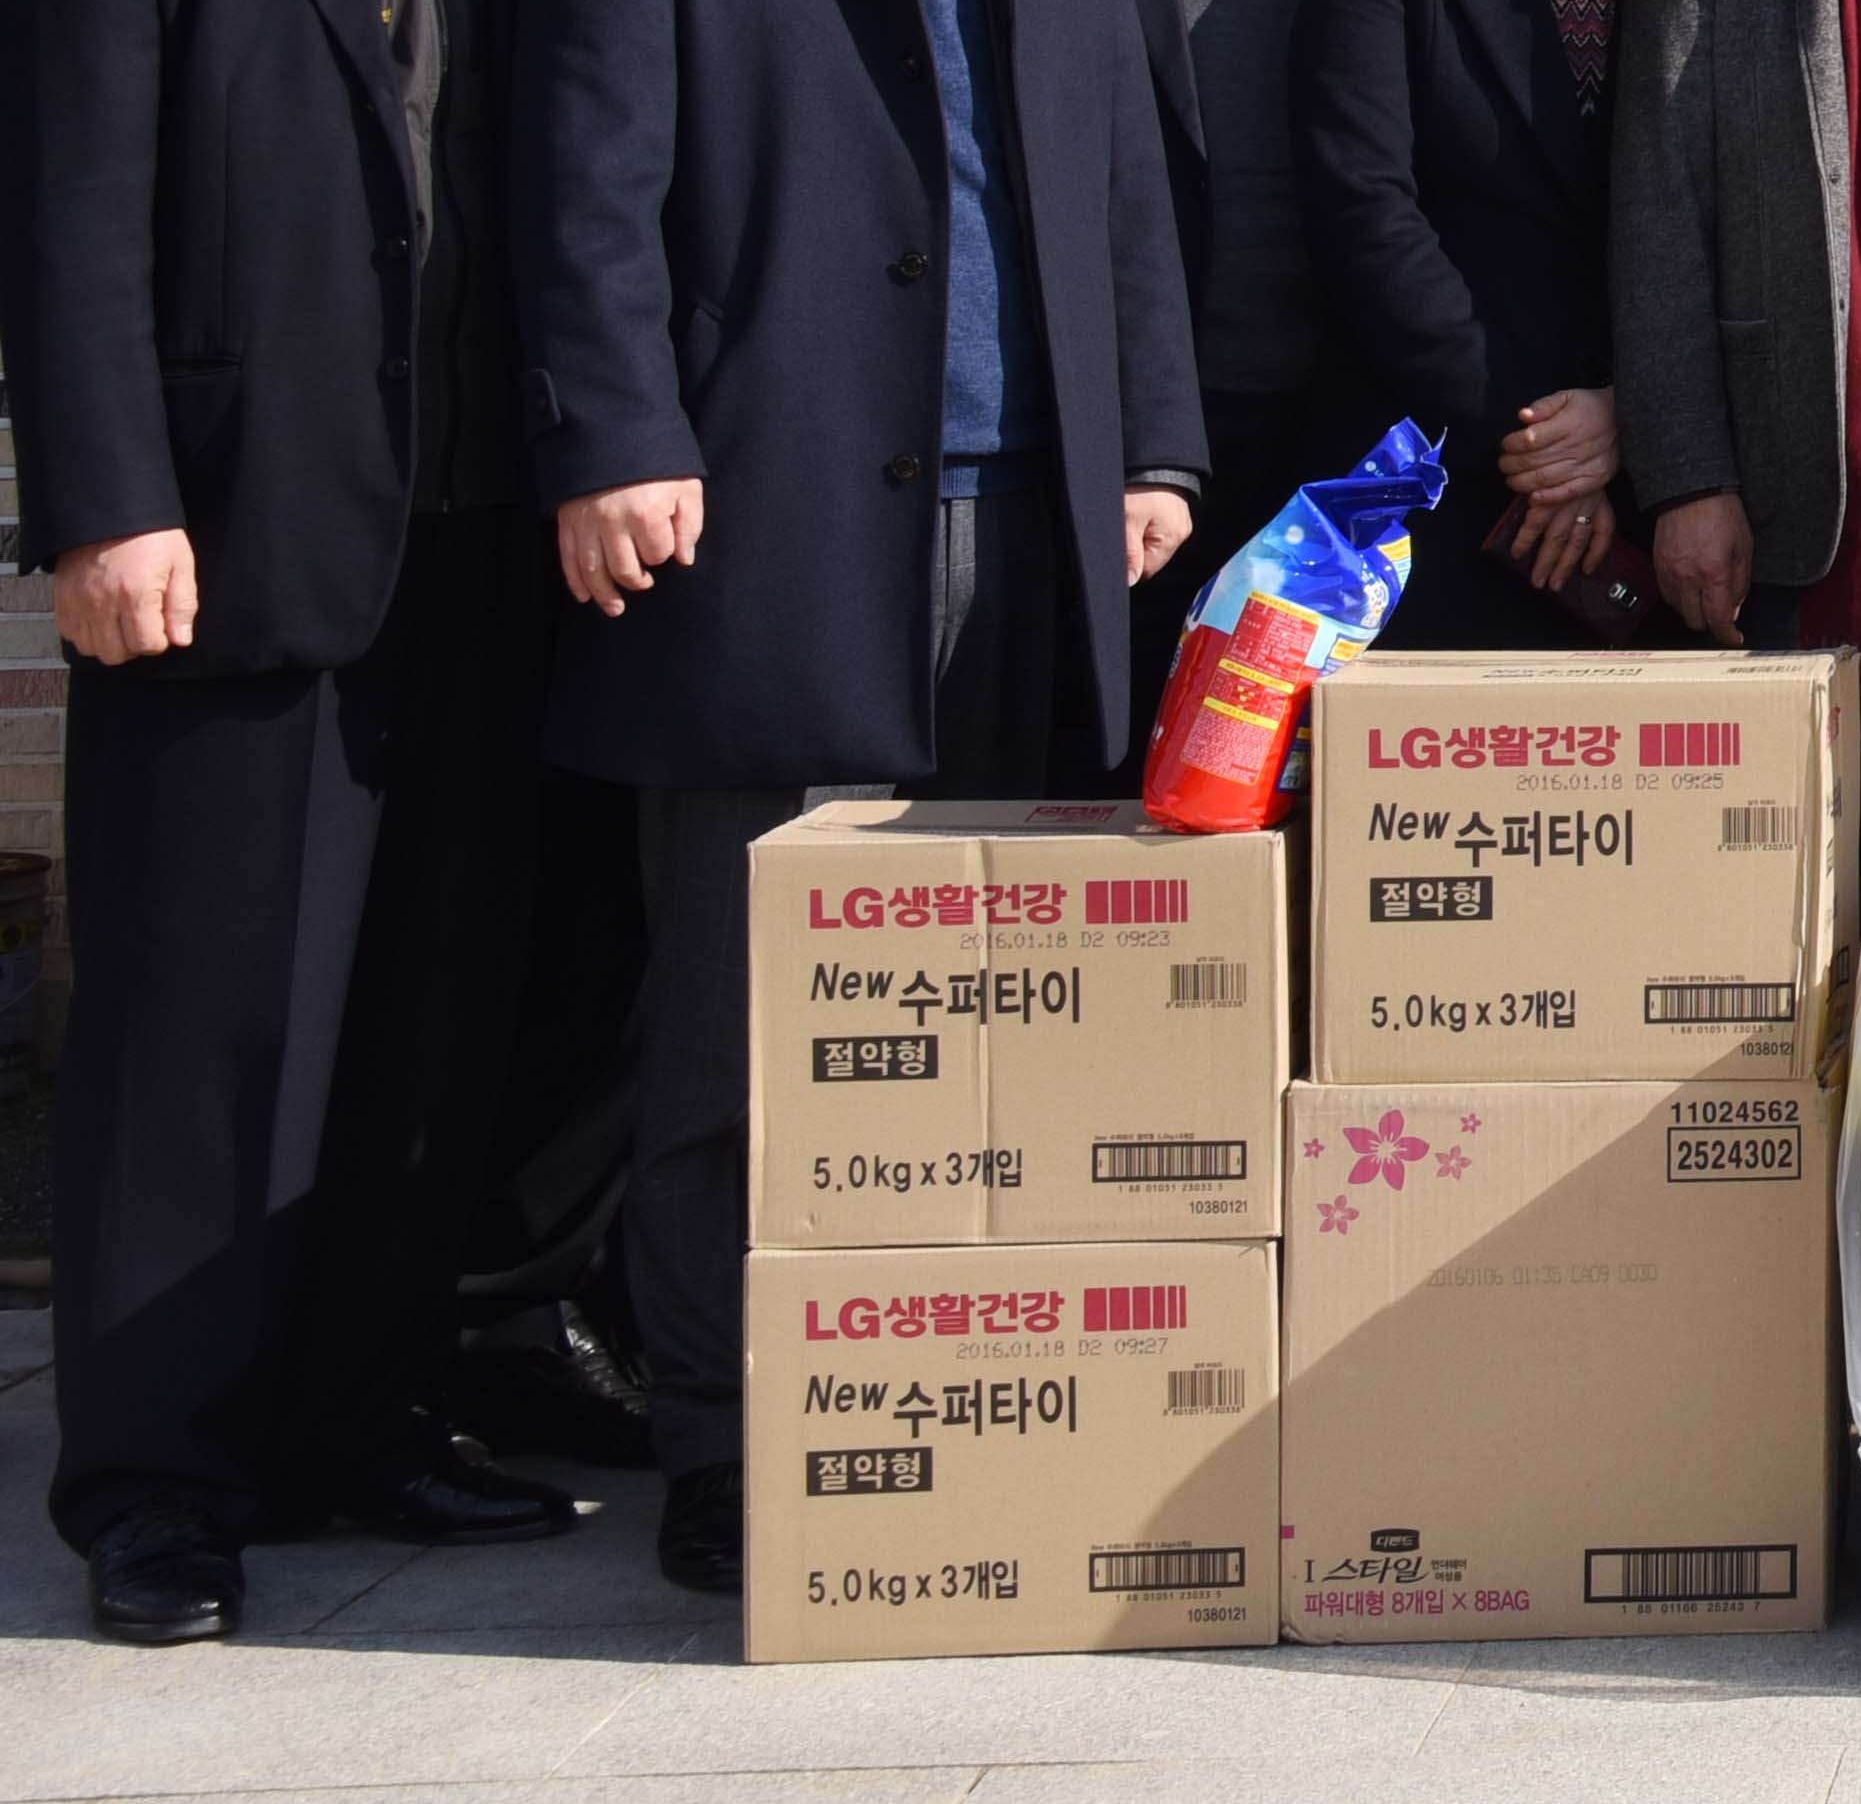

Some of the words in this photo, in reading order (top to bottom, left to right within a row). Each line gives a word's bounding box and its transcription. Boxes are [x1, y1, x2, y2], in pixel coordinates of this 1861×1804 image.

[1368, 726, 1620, 769] LG생활건강
[1516, 775, 1623, 791] 2016.01.18
[1671, 773, 1724, 790] 09:25
[1368, 802, 1449, 842] New
[1454, 809, 1633, 868] 수퍼타이
[810, 884, 1066, 929] LG생활건강
[1382, 882, 1482, 917] 절약형
[960, 932, 1068, 950] 2016.01.18
[1116, 931, 1170, 947] 09:23
[811, 962, 894, 1001] New
[899, 967, 1080, 1026] 수퍼타이
[824, 1041, 927, 1077] 절약형
[1671, 1101, 1799, 1123] 11024562
[1678, 1139, 1792, 1170] 2524302
[1189, 1200, 1247, 1214] 10380121
[805, 1291, 1064, 1340] LG생활건강
[956, 1342, 1065, 1360] 2016.01.18
[1114, 1338, 1168, 1356] 09:27
[805, 1375, 889, 1414] New
[893, 1376, 1077, 1438] 수퍼타이
[817, 1453, 921, 1491] 절약형
[1322, 1556, 1429, 1584] 스타일
[1187, 1608, 1247, 1622] 10380121
[1305, 1591, 1384, 1617] 파워대형
[1392, 1589, 1444, 1614] 8개입
[1475, 1590, 1529, 1612] 8BAG
